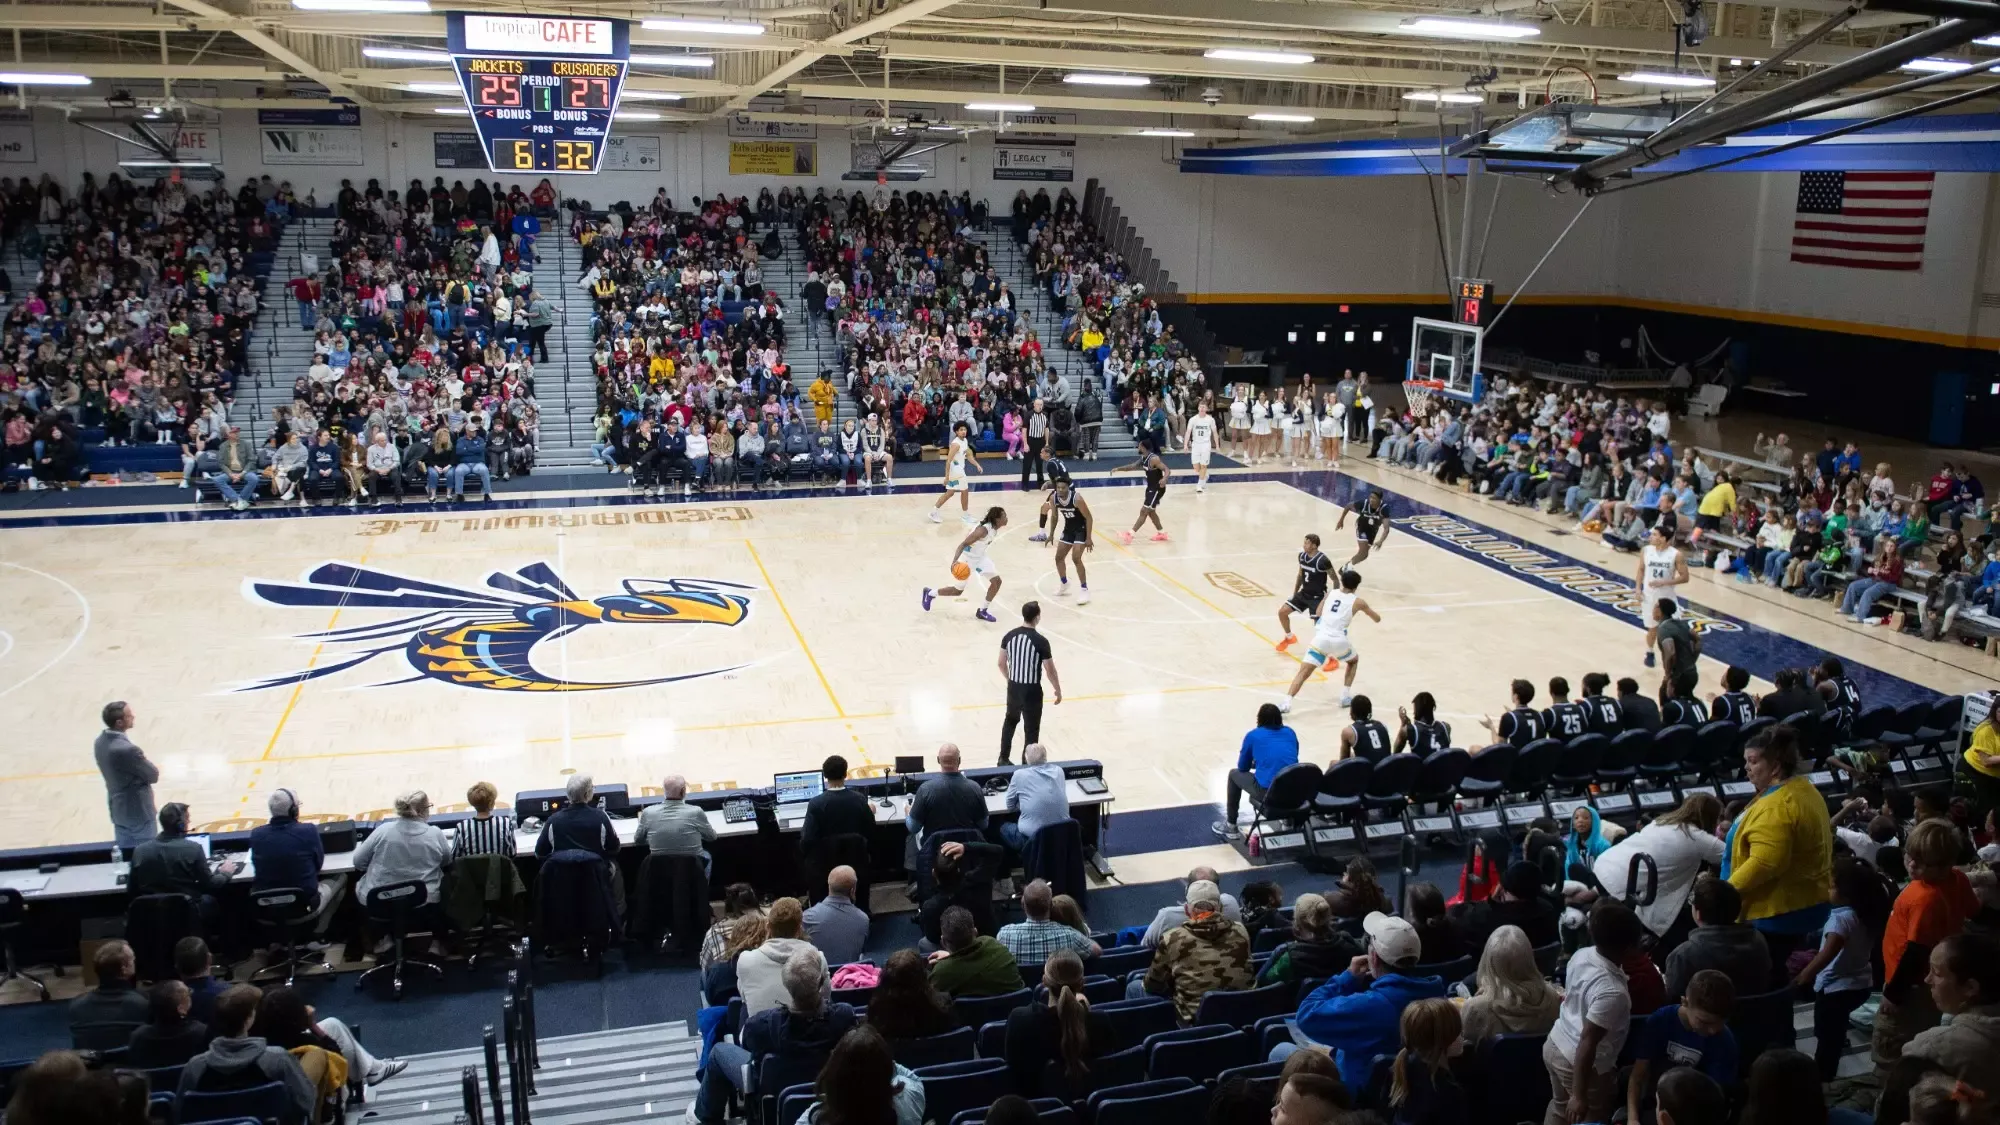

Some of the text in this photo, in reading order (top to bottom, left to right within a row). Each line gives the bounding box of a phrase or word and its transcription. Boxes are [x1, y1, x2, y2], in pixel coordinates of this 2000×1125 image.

[485, 19, 597, 44] tropical CAFE
[469, 60, 523, 74] JACKETS
[553, 62, 618, 76] CRUSADERS
[481, 75, 520, 105] 25
[522, 75, 560, 87] PERIOD
[543, 87, 549, 111] 1
[571, 78, 608, 107] 27
[496, 109, 532, 120] BONUS
[553, 110, 588, 122] BONUS
[532, 125, 554, 134] POSS
[514, 141, 592, 170] 6:32
[733, 143, 791, 154] Edward Jones
[1013, 154, 1047, 162] LEGACY
[1463, 282, 1484, 298] 6:32
[1464, 299, 1478, 324] 19
[1304, 571, 1309, 582] 2
[1391, 514, 1745, 637] YELLOW JACKES
[1652, 568, 1664, 579] 24
[1331, 599, 1342, 613] 2
[1600, 703, 1618, 723] 13
[1691, 705, 1706, 723] 11
[1739, 704, 1752, 722] 15
[1526, 719, 1537, 739] 7
[1562, 714, 1582, 735] 25
[1367, 729, 1383, 750] 8
[1430, 733, 1441, 752] 4
[542, 801, 549, 812] B
